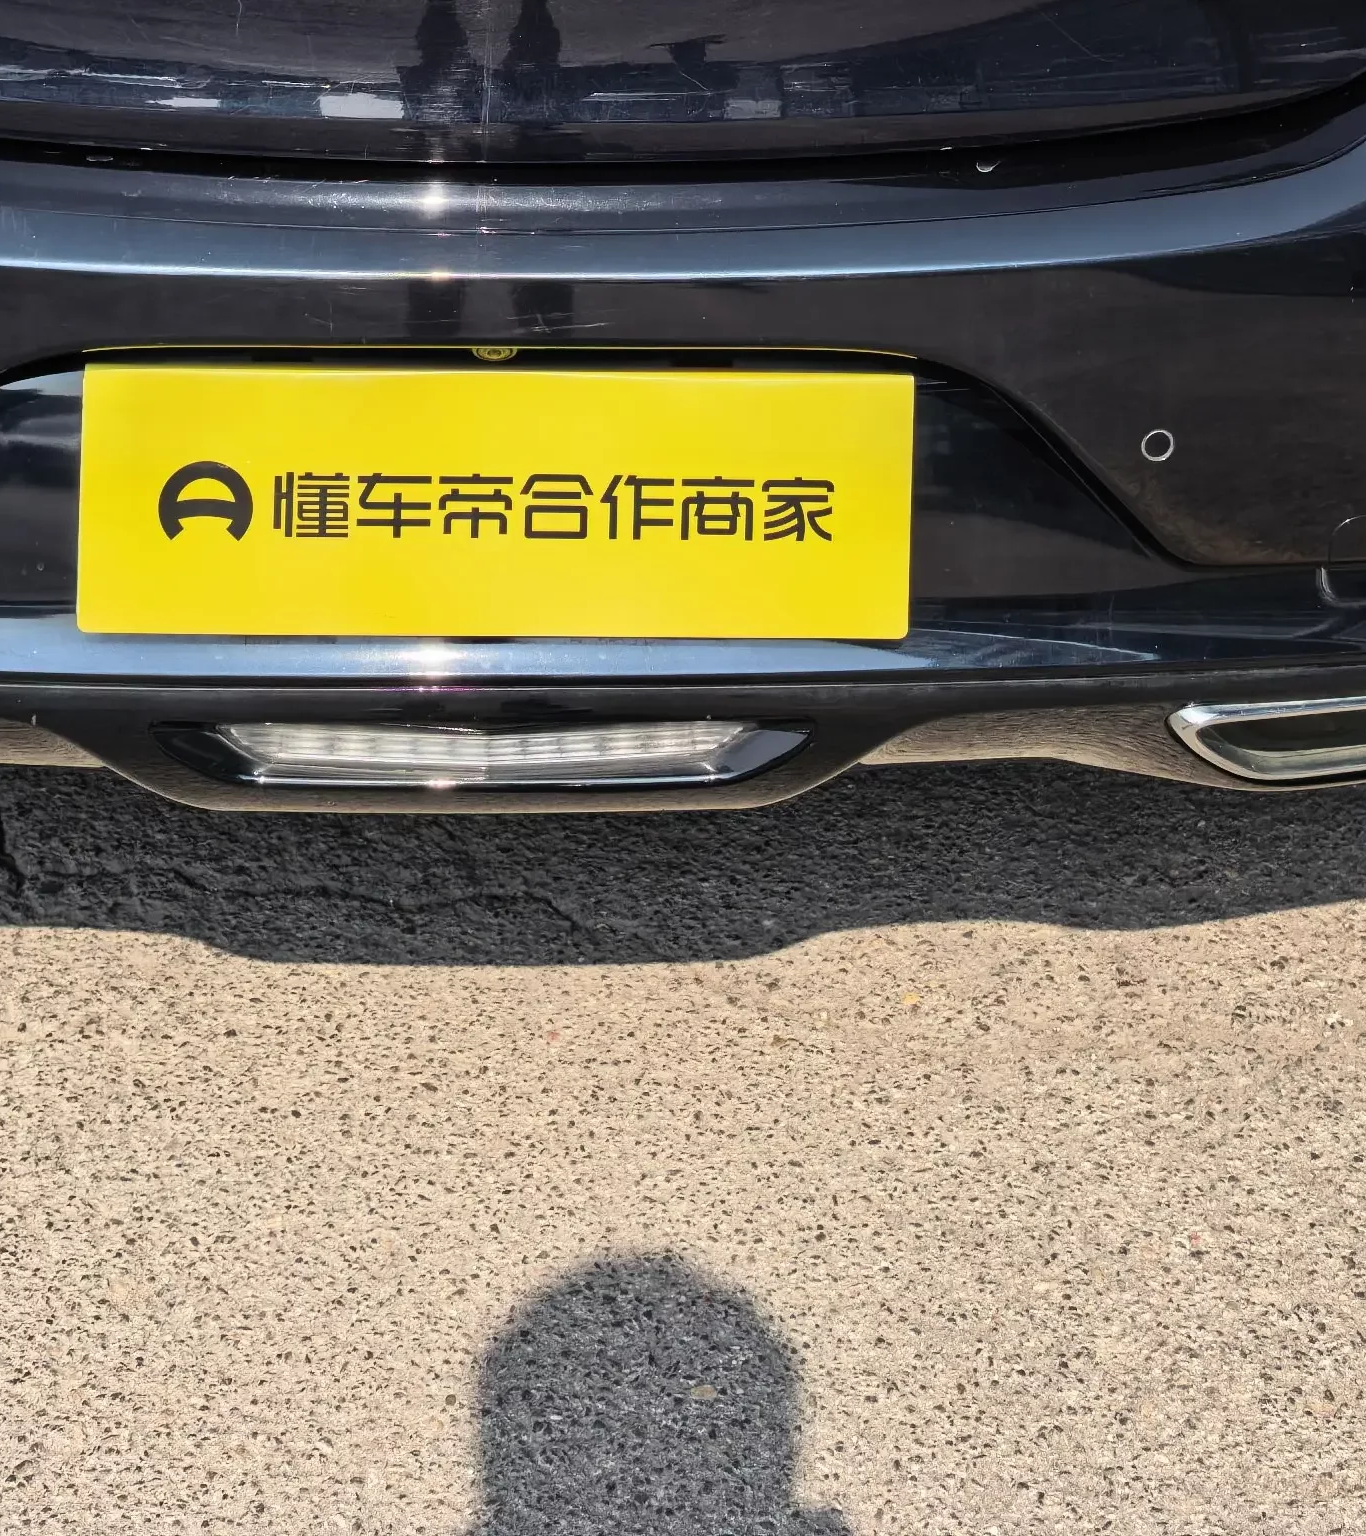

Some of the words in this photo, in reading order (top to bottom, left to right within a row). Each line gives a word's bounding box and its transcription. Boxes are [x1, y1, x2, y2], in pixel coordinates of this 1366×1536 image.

[273, 470, 836, 542] 懂车帝合作商家
